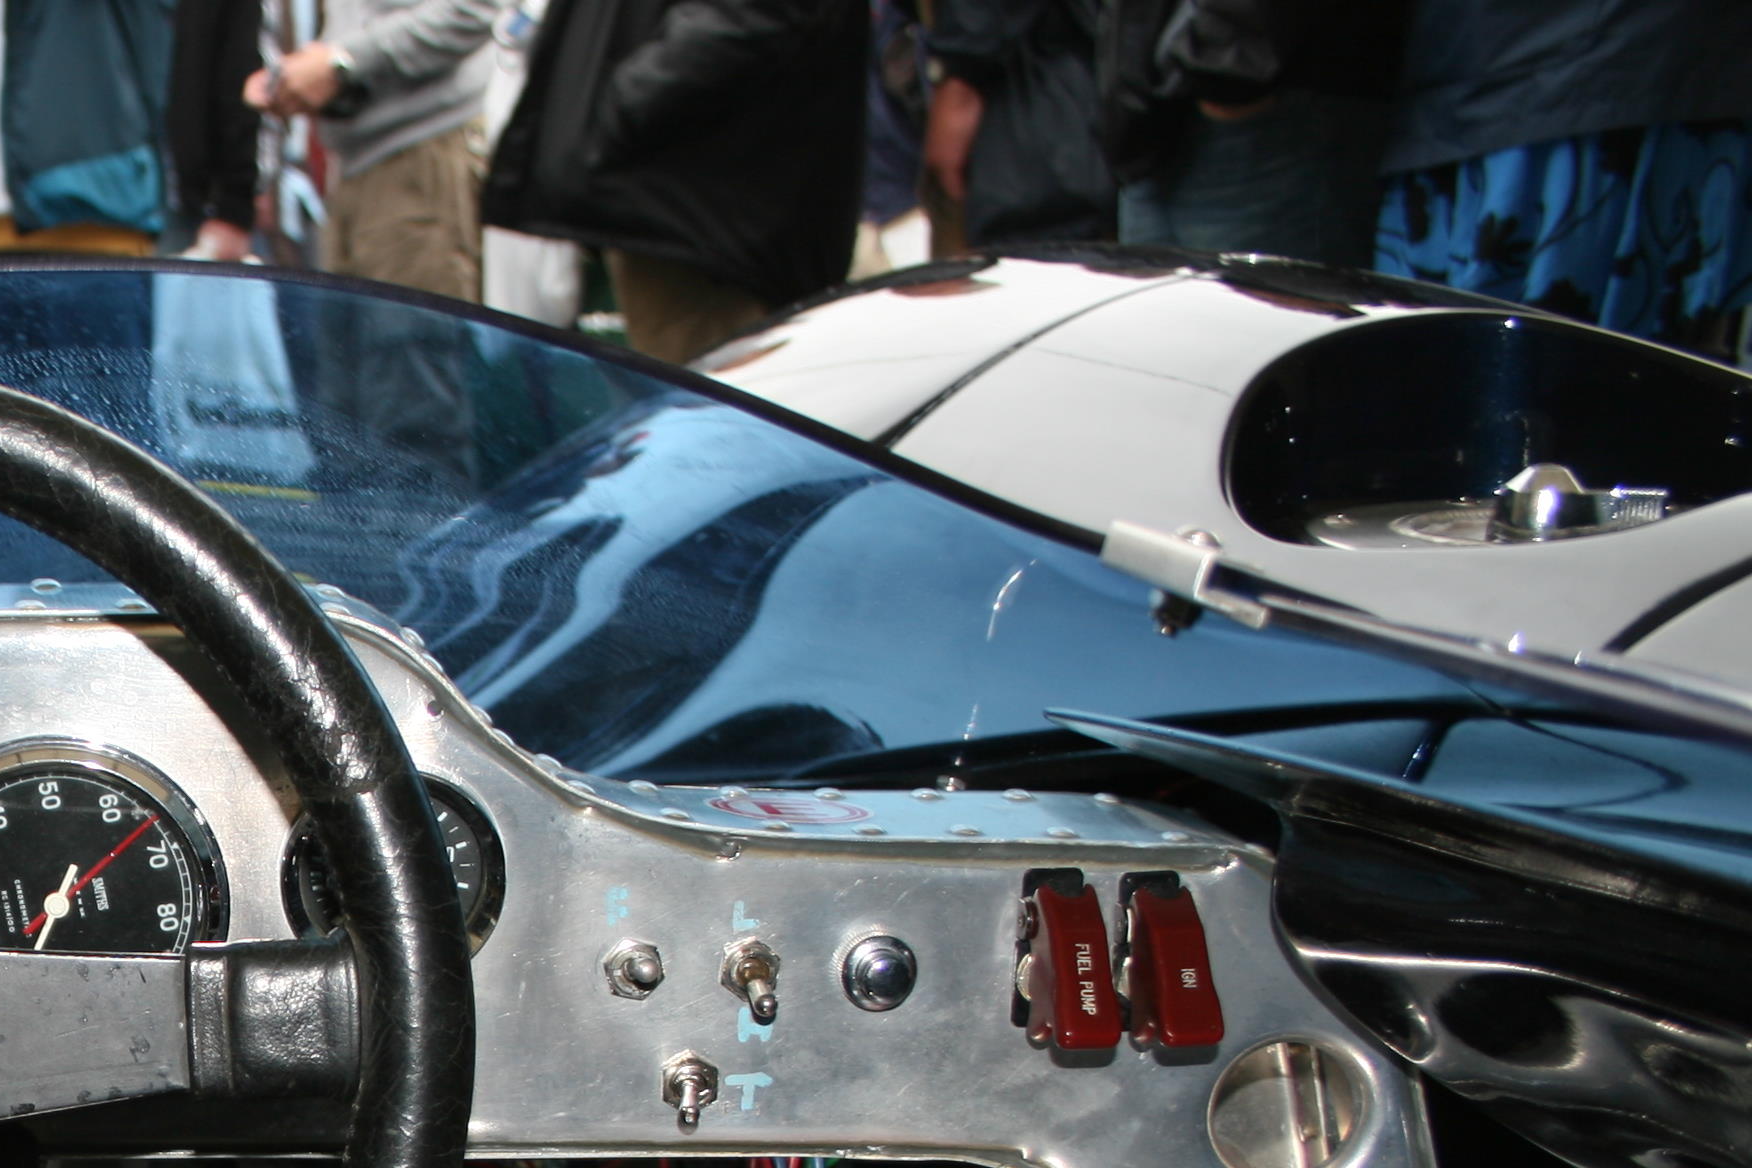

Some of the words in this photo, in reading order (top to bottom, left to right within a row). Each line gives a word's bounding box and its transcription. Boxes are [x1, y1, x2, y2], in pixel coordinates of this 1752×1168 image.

[38, 781, 62, 810] 50
[98, 794, 121, 823] 60
[146, 840, 168, 869] 70
[92, 877, 110, 911] SMITHS
[157, 903, 179, 931] 80
[733, 900, 759, 932] L
[1075, 943, 1093, 975] FUEL
[1180, 968, 1196, 988] IGN
[1079, 981, 1097, 1016] PUMP
[725, 1072, 772, 1110] T
